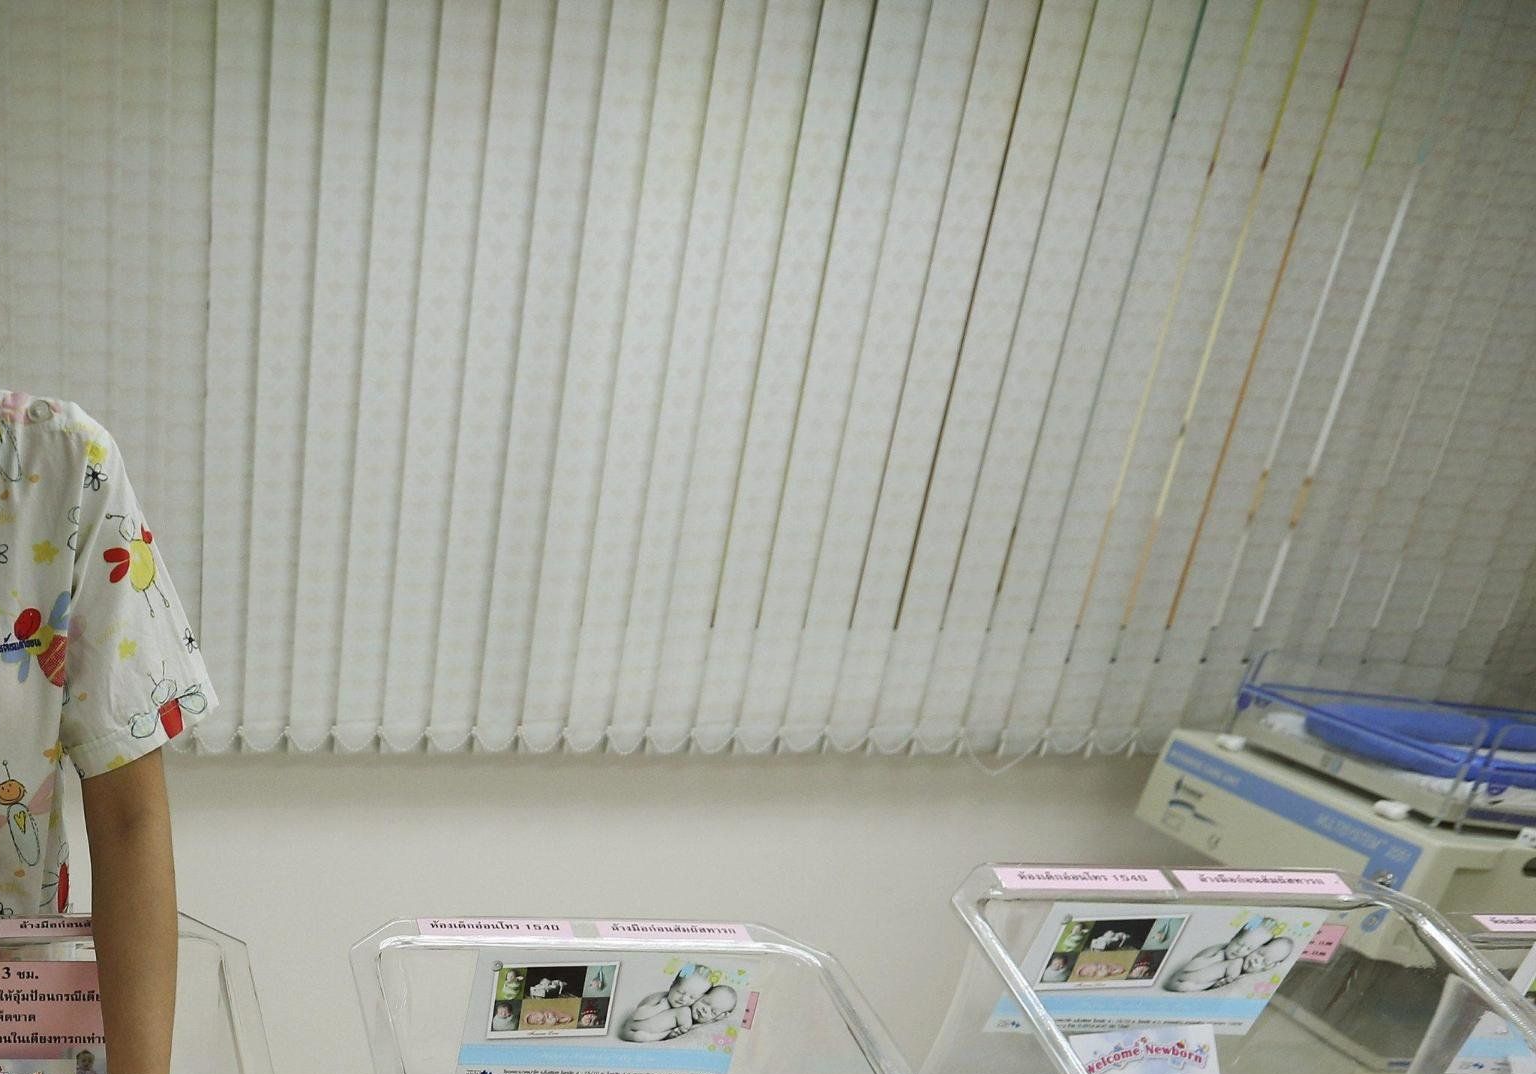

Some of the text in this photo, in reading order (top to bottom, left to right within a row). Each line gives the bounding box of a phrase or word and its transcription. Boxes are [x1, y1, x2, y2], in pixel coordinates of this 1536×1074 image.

[525, 923, 561, 932] 1540
[2, 966, 12, 980] 3
[16, 970, 39, 980] ชม.
[1087, 1044, 1203, 1074] Welcome Newborn
